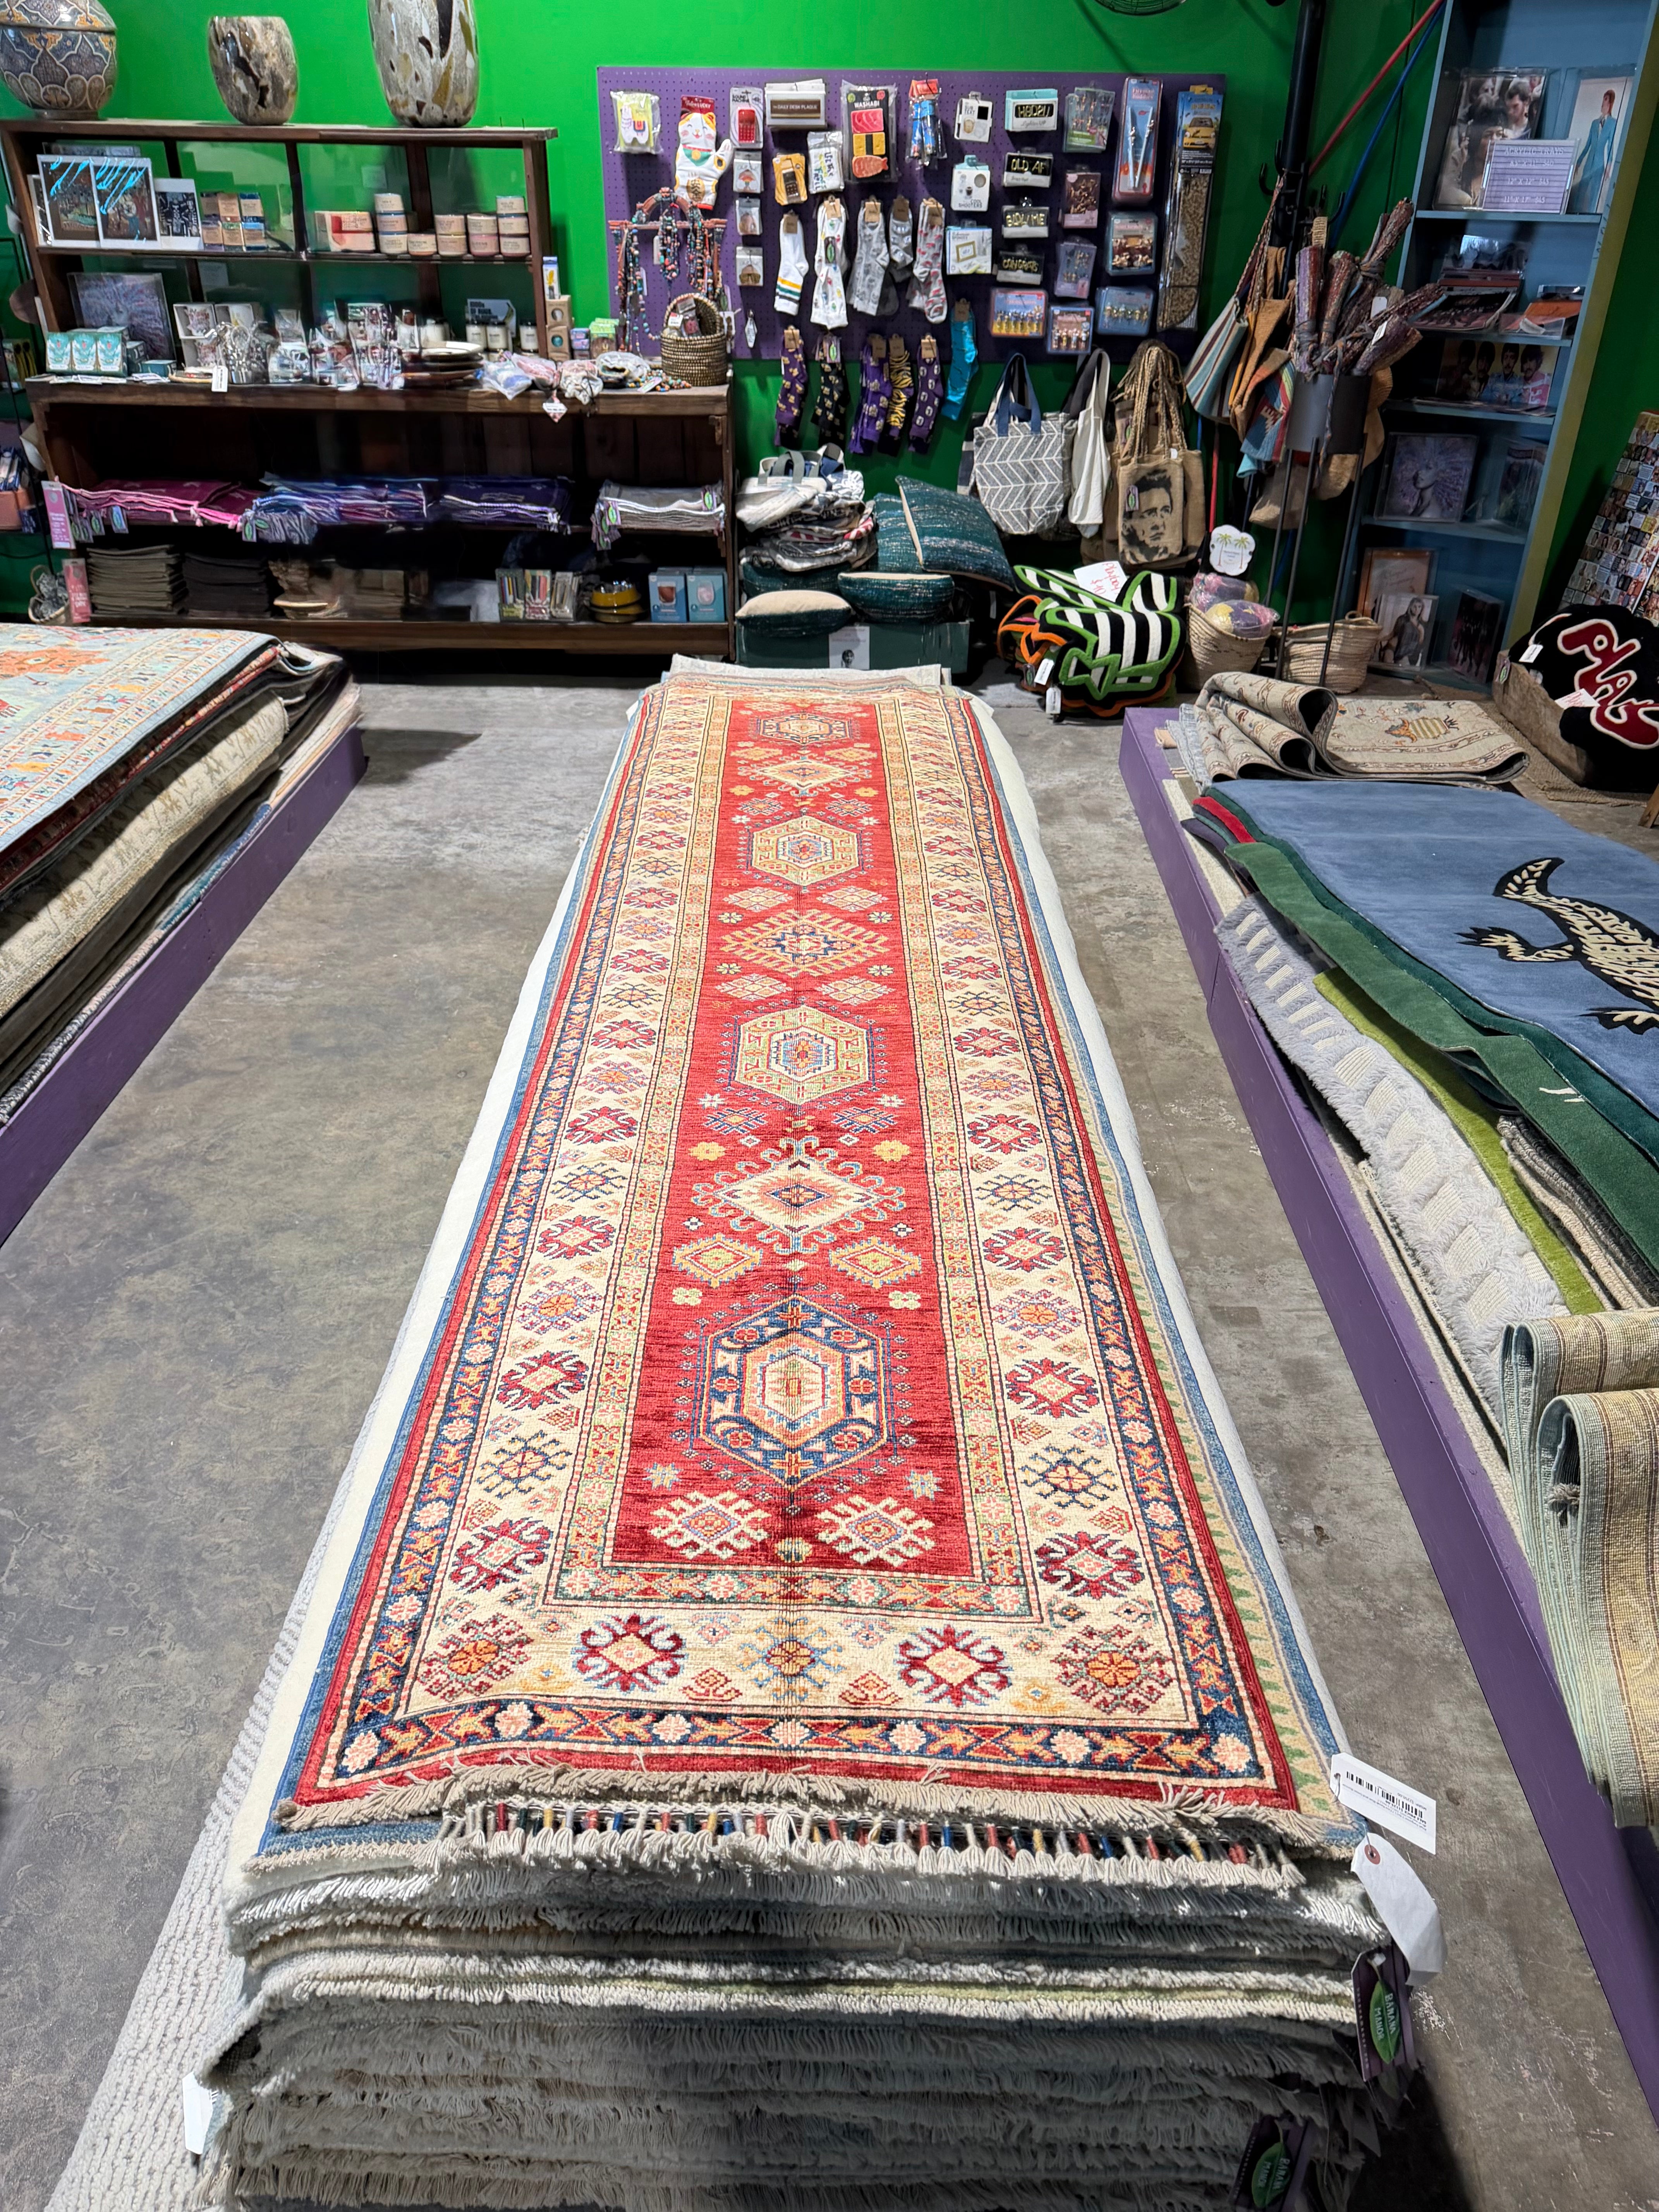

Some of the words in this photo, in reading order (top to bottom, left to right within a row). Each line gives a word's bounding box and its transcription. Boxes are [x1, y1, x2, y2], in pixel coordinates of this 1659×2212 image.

[1374, 2007, 1384, 2040] MANOR
[1384, 1992, 1396, 2034] BANANA
[1258, 2161, 1272, 2188] MANOR
[1273, 2158, 1290, 2189] BANANA
